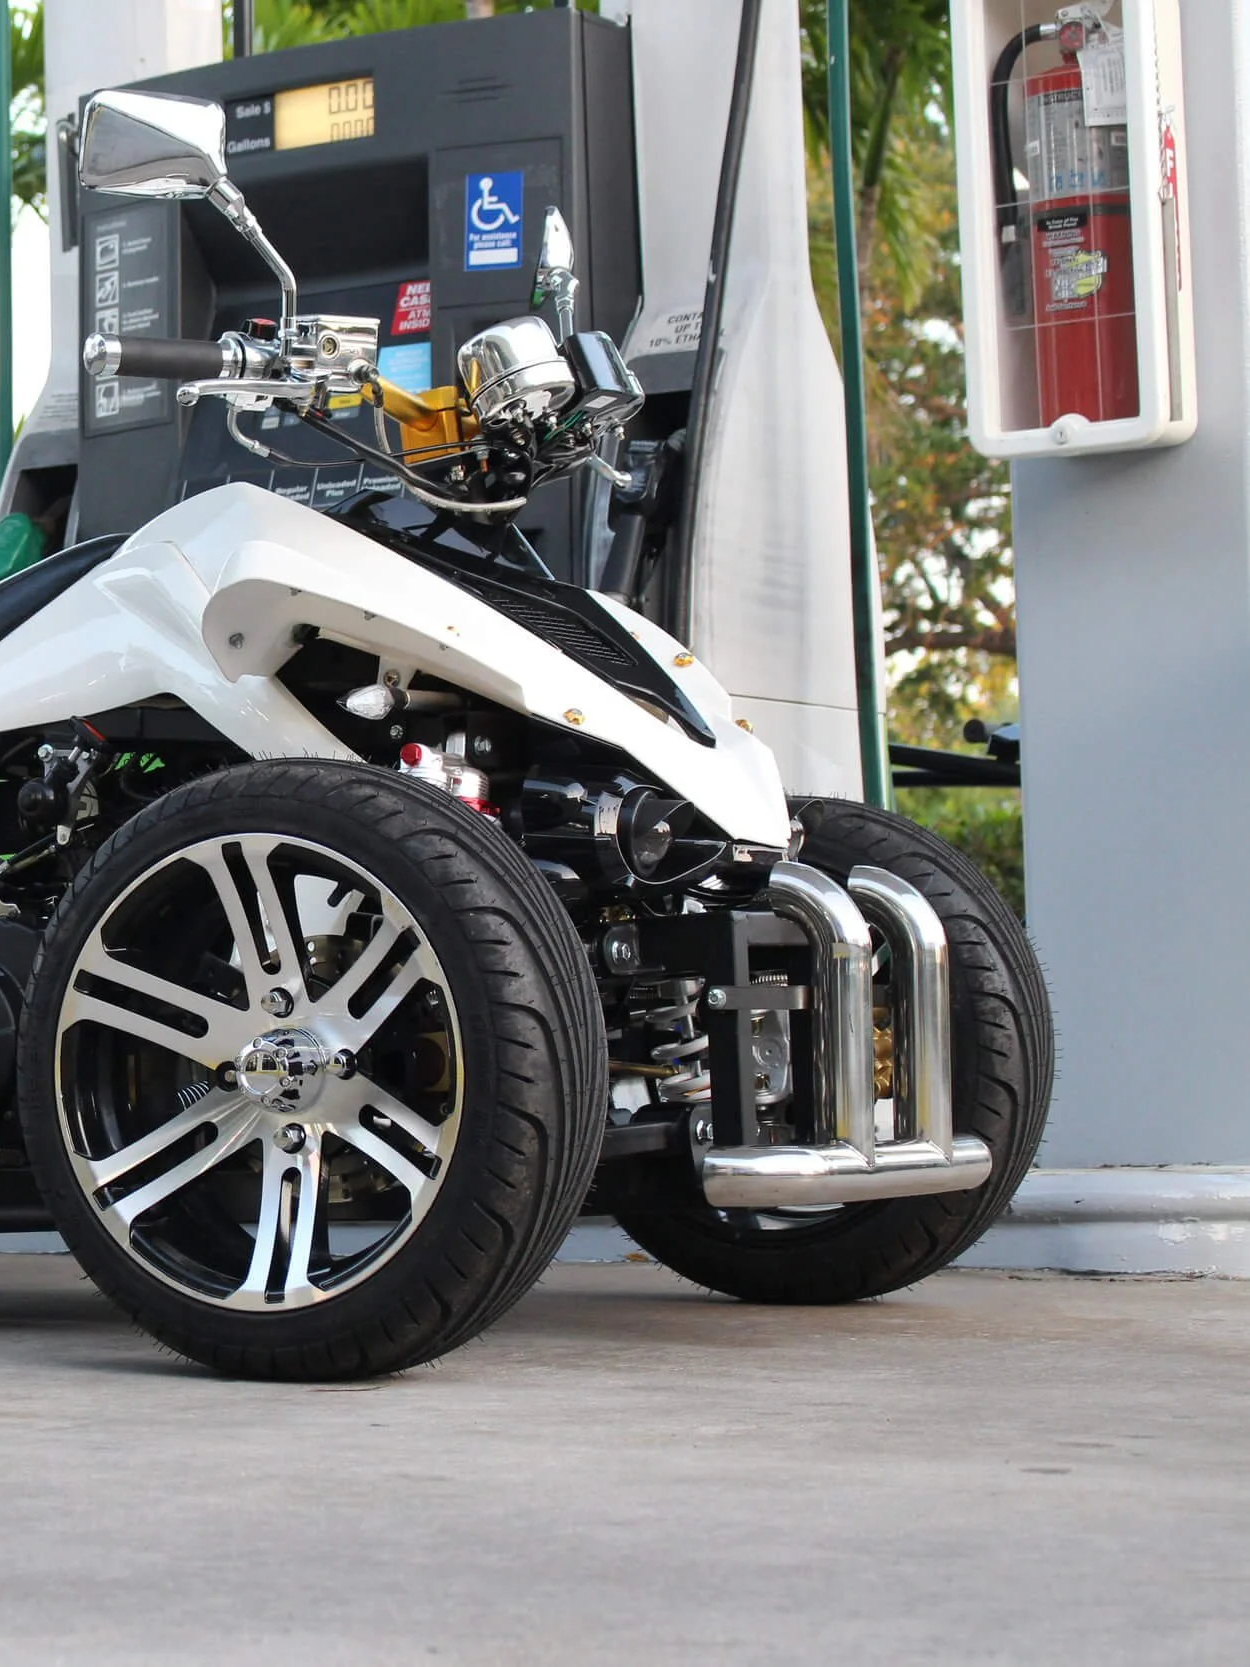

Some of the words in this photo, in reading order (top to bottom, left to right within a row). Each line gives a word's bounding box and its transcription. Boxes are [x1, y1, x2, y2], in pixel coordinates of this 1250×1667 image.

[236, 104, 261, 119] Sale
[264, 101, 271, 114] $
[227, 137, 271, 154] Gallons
[400, 294, 430, 308] CAS
[650, 338, 671, 347] 10%
[275, 486, 308, 495] Regular
[317, 480, 356, 490] Unleaded
